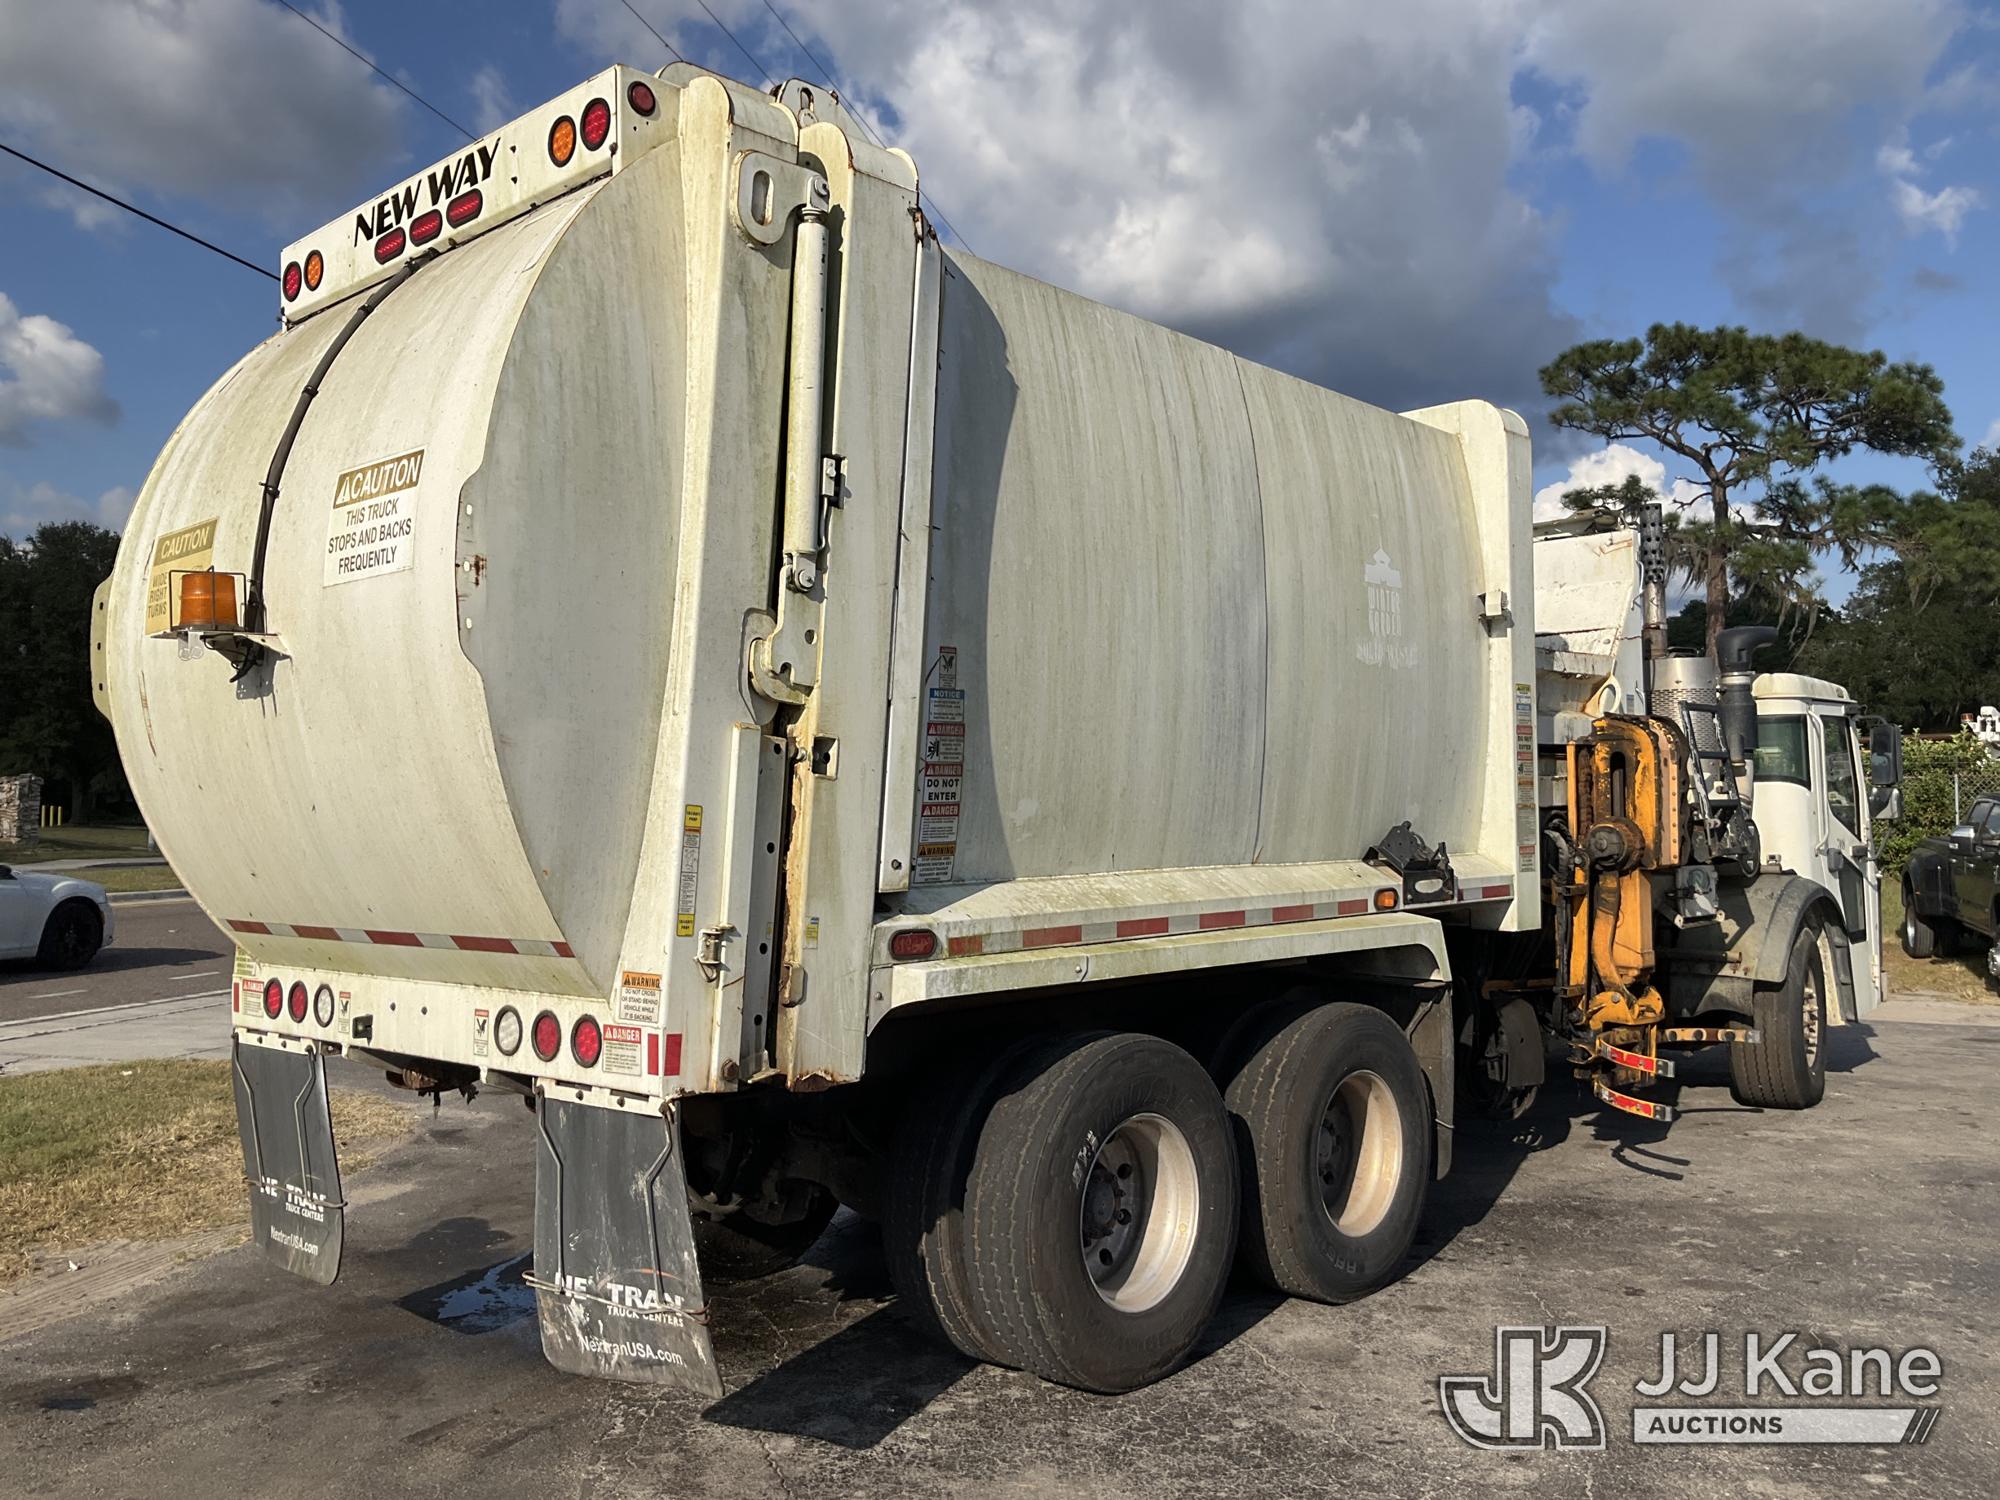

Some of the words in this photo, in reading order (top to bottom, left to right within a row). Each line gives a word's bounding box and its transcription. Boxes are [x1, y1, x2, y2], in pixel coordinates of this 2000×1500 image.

[354, 179, 422, 247] NEW
[428, 137, 501, 206] WAY
[351, 455, 422, 499] CAUTION
[346, 507, 365, 527] THIS
[367, 497, 399, 522] TRUCK
[161, 526, 210, 559] CAUTION
[328, 532, 357, 554] STOPS
[357, 527, 377, 547] AND
[379, 518, 412, 542] BACKS
[339, 545, 398, 575] FREQUENTLY
[150, 586, 168, 603] RIGHT
[148, 601, 167, 619] TURNS
[934, 690, 961, 698] NOTICE
[937, 725, 964, 735] DANGER
[934, 766, 962, 775] DANGER
[927, 779, 939, 788] DO
[942, 779, 960, 788] NOT
[928, 792, 957, 801] ENTER
[931, 805, 958, 815] DANGER
[927, 846, 954, 855] WARNING
[631, 976, 661, 989] WARNING
[613, 1027, 641, 1041] DANGER
[271, 1225, 318, 1256] NextranUSA.com
[607, 1305, 640, 1320] TRUCK
[643, 1312, 684, 1328] CENTERS
[581, 1335, 683, 1365] NextranUSA.com
